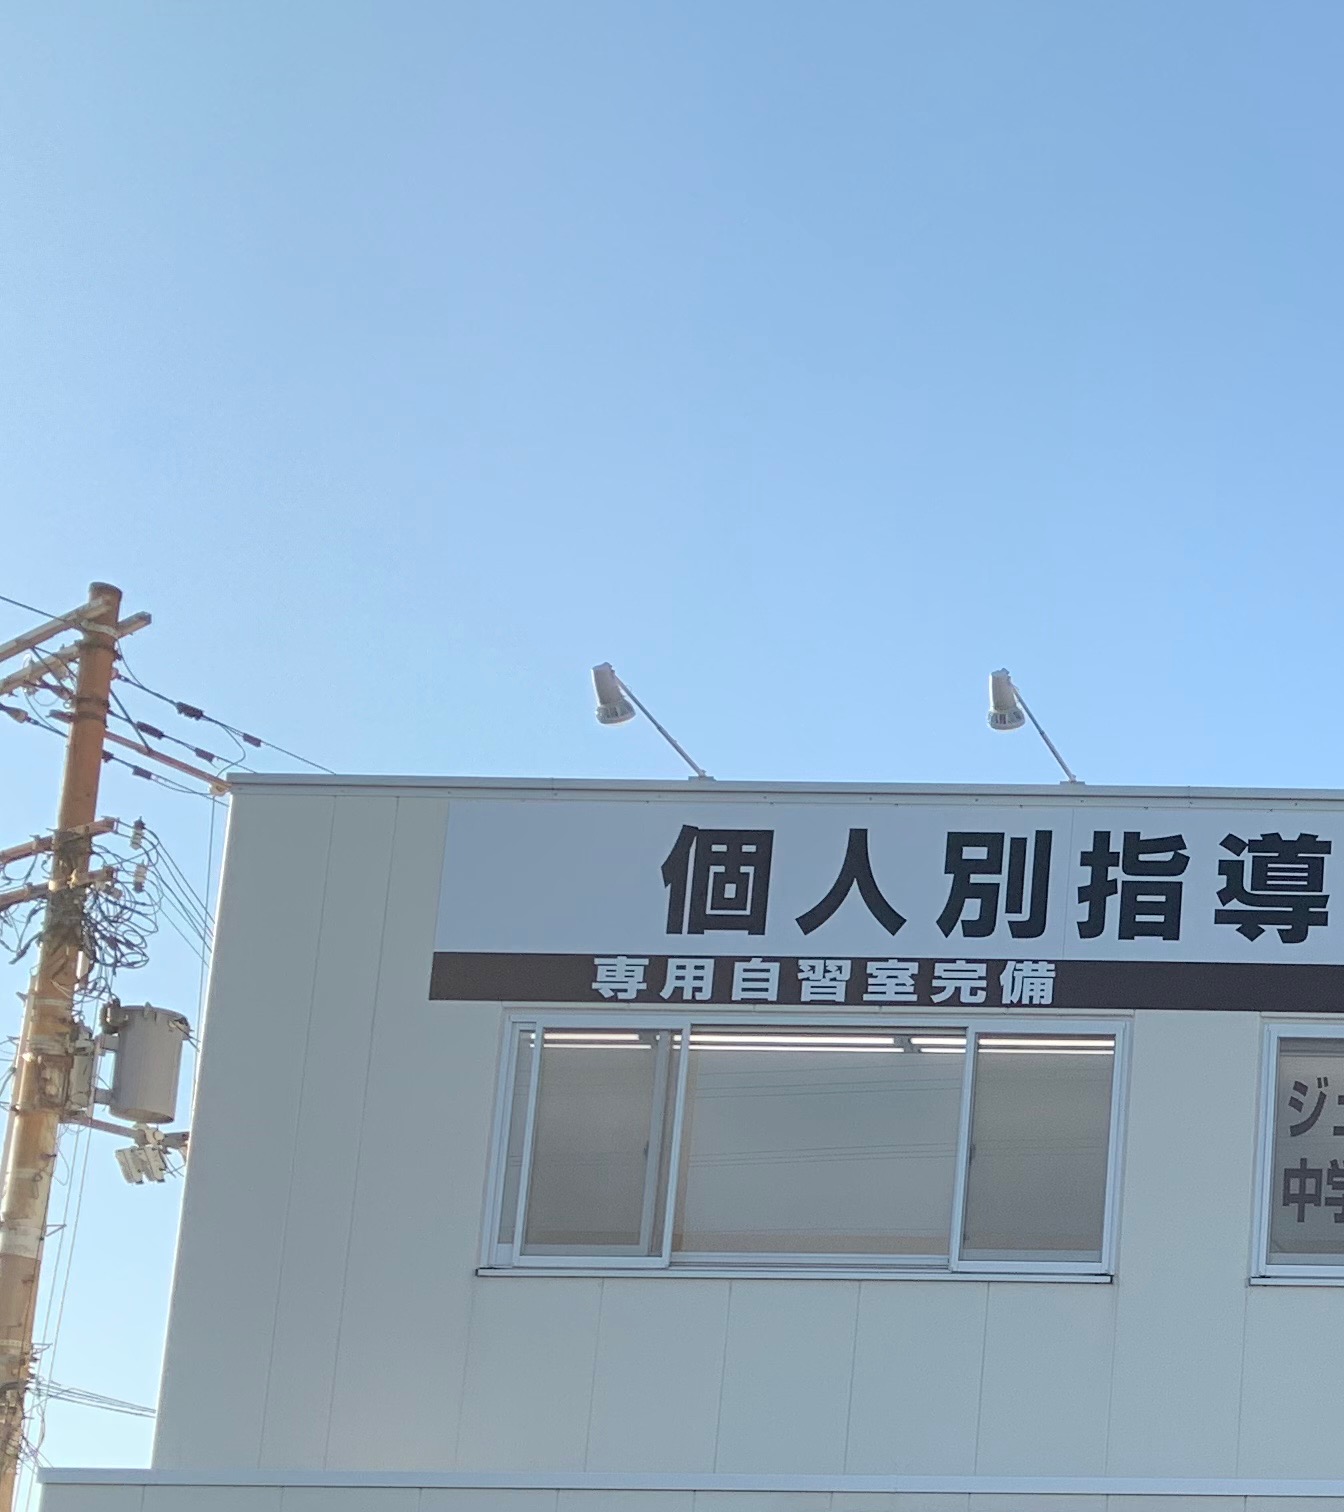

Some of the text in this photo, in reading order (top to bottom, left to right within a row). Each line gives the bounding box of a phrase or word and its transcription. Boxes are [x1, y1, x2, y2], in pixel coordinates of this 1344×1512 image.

[592, 955, 1058, 1005] 専用自習室完備
